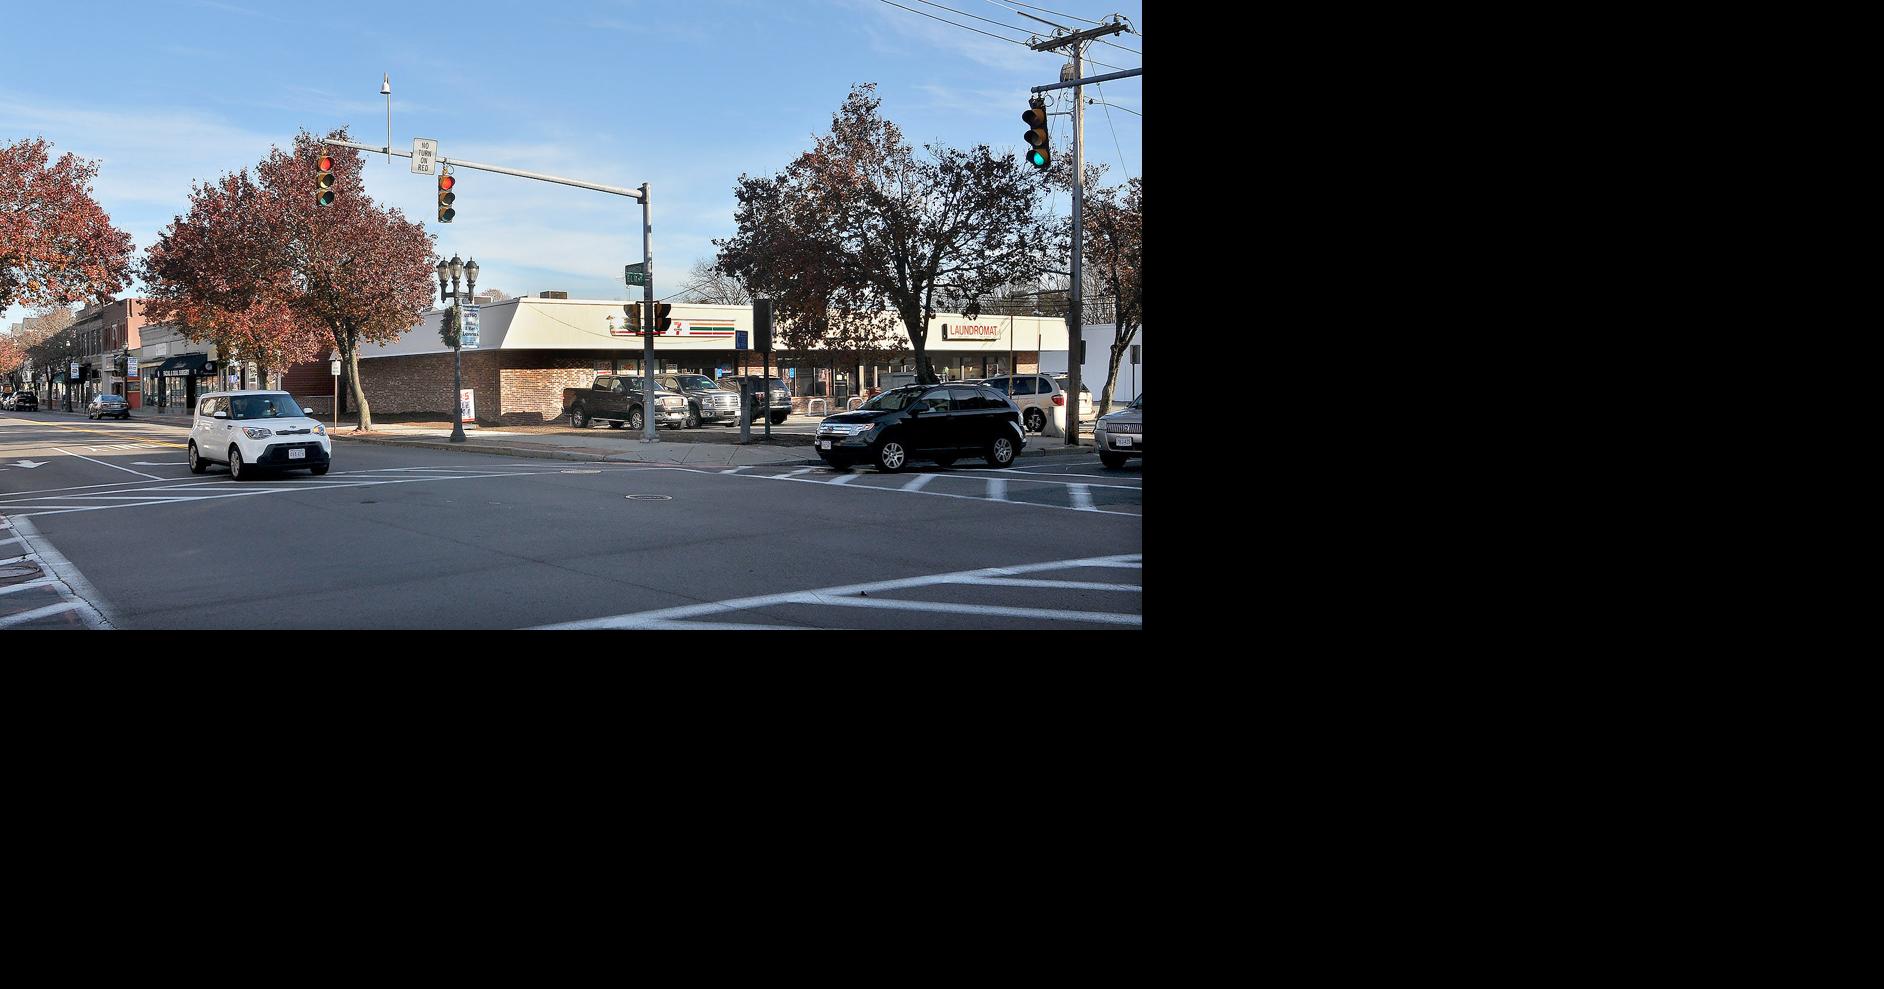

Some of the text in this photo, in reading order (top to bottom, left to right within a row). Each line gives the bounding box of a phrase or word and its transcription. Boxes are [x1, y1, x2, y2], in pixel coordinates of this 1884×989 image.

[418, 149, 432, 157] TURN
[417, 164, 429, 172] RED
[950, 324, 998, 336] LAUNDROMAT
